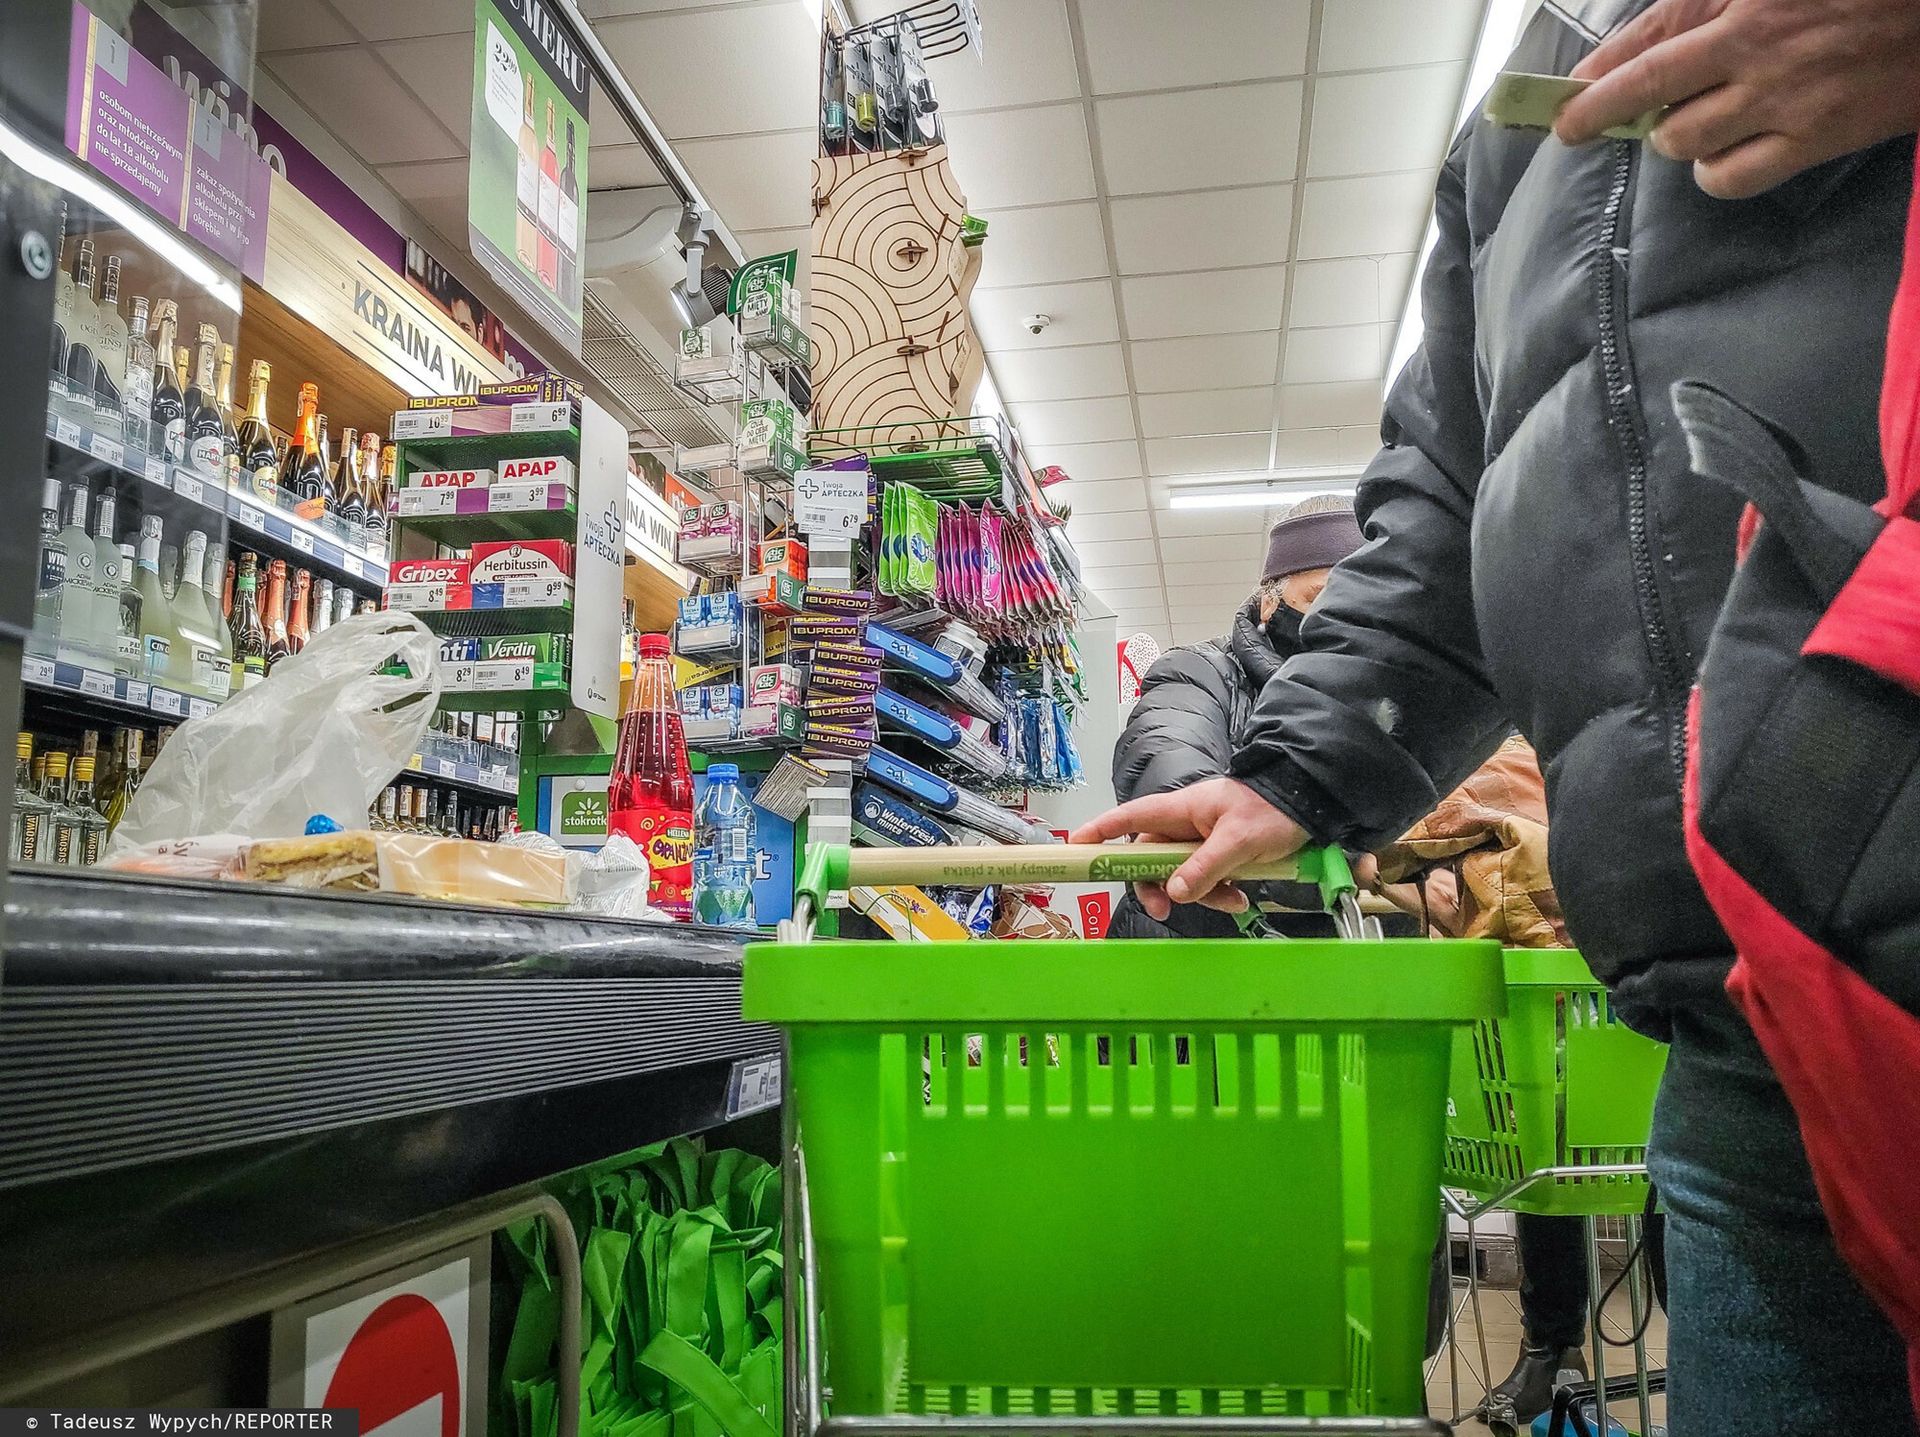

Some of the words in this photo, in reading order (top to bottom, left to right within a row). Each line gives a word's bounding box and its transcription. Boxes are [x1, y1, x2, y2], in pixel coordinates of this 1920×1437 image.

[511, 0, 587, 93] MERU
[98, 107, 117, 128] oraz
[118, 120, 160, 160] młodzieży
[99, 90, 133, 121] osobom
[134, 114, 183, 161] nietrzeźwym
[96, 123, 108, 138] do
[110, 130, 122, 148] lat
[123, 142, 133, 157] 18
[134, 150, 169, 185] alkoholu
[95, 140, 109, 157] nie
[110, 152, 162, 197] sprzedajemy
[196, 166, 218, 188] zakaz
[195, 182, 227, 211] alkoholu
[194, 197, 225, 225] sklepem
[353, 279, 444, 381] KRAINA
[451, 356, 483, 394] WI
[480, 383, 539, 396] IBUPROM
[409, 396, 479, 409] IBUPROM
[503, 461, 557, 478] APAP
[421, 472, 476, 488] APAP
[821, 480, 843, 490] Twoja
[585, 512, 603, 538] Twoja
[650, 516, 674, 554] WIN
[584, 533, 620, 567] APTECZKA
[398, 565, 458, 583] Gripex
[484, 558, 548, 572] Herbitussin
[805, 595, 868, 608] IBUPROM
[793, 627, 856, 635] IBUPROM
[488, 638, 537, 659] Verdin
[817, 651, 879, 666] IBUPROM
[812, 675, 875, 691] IBUPROM
[808, 705, 872, 717] IBUPROM
[807, 733, 870, 748] IBUPROM
[877, 817, 903, 835] mints
[881, 808, 935, 845] Winterfresh
[987, 866, 994, 875] z
[998, 863, 1017, 877] jak
[1020, 863, 1067, 877] zakupy
[1111, 863, 1179, 878] okrotka
[1084, 900, 1101, 940] Con
